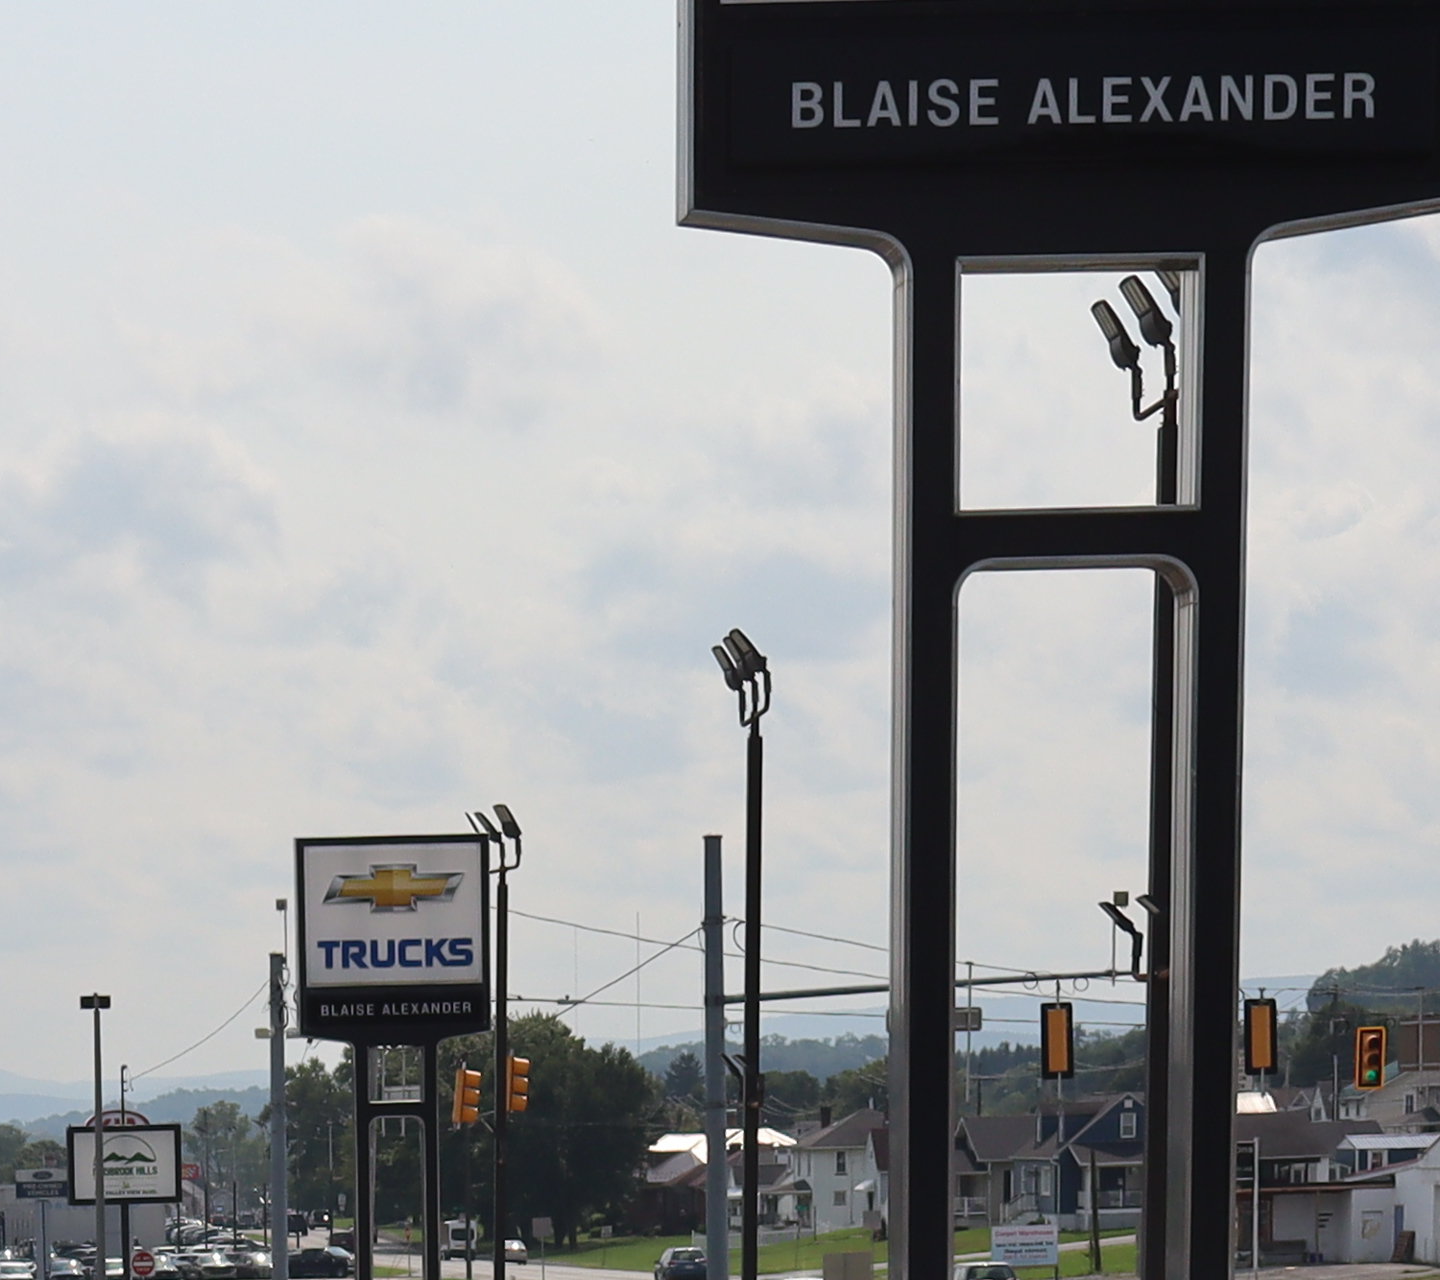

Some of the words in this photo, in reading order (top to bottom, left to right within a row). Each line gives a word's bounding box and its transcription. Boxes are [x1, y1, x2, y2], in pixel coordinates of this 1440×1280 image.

[791, 78, 1000, 128] BLAISE
[1026, 72, 1376, 125] ALEXANDER
[317, 938, 473, 969] TRUCKS
[320, 1003, 375, 1017] BLAISE
[382, 1001, 472, 1016] ALEXANDER
